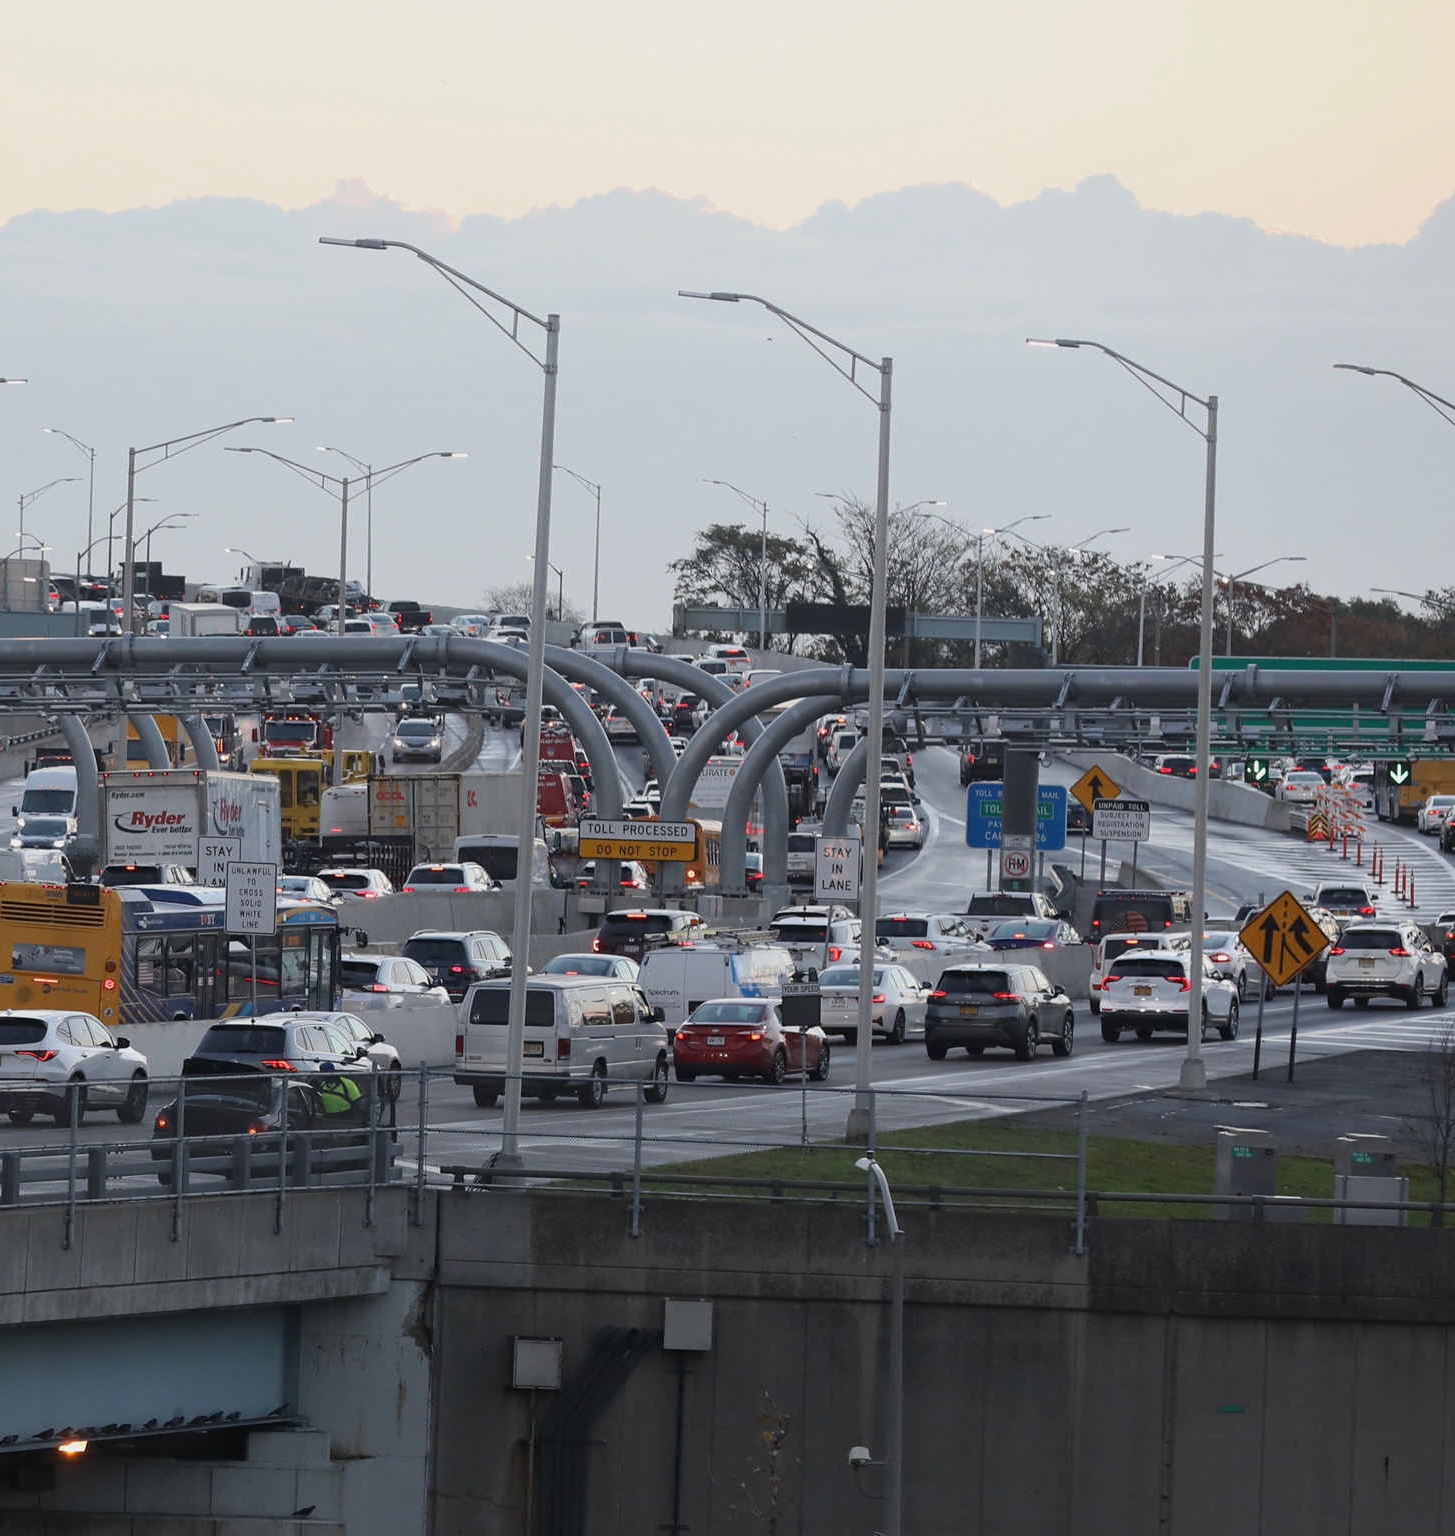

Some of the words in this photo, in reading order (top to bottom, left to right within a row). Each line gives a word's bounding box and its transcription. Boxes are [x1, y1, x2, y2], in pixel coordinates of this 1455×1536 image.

[111, 791, 145, 799] Ryder.com
[975, 789, 993, 797] TOLL
[220, 798, 242, 827] Ryder
[984, 803, 1002, 814] TOL
[131, 811, 185, 828] Ryder
[1100, 811, 1130, 819] SUBJECT
[588, 823, 615, 834] TOLL
[622, 825, 688, 837] PROCESSED
[205, 846, 233, 857] STAY
[596, 845, 613, 855] DO
[619, 846, 641, 856] NOT
[649, 846, 678, 857] STOP
[823, 847, 852, 858] STAY
[213, 862, 225, 873] IN
[231, 867, 272, 876] UNLAWFUL
[831, 864, 843, 874] IN
[203, 878, 226, 886] LAN
[247, 878, 257, 886] TO
[822, 880, 852, 891] LANE
[239, 888, 264, 897] CROSS
[240, 899, 262, 908] SOLID
[239, 911, 262, 919] WHITE
